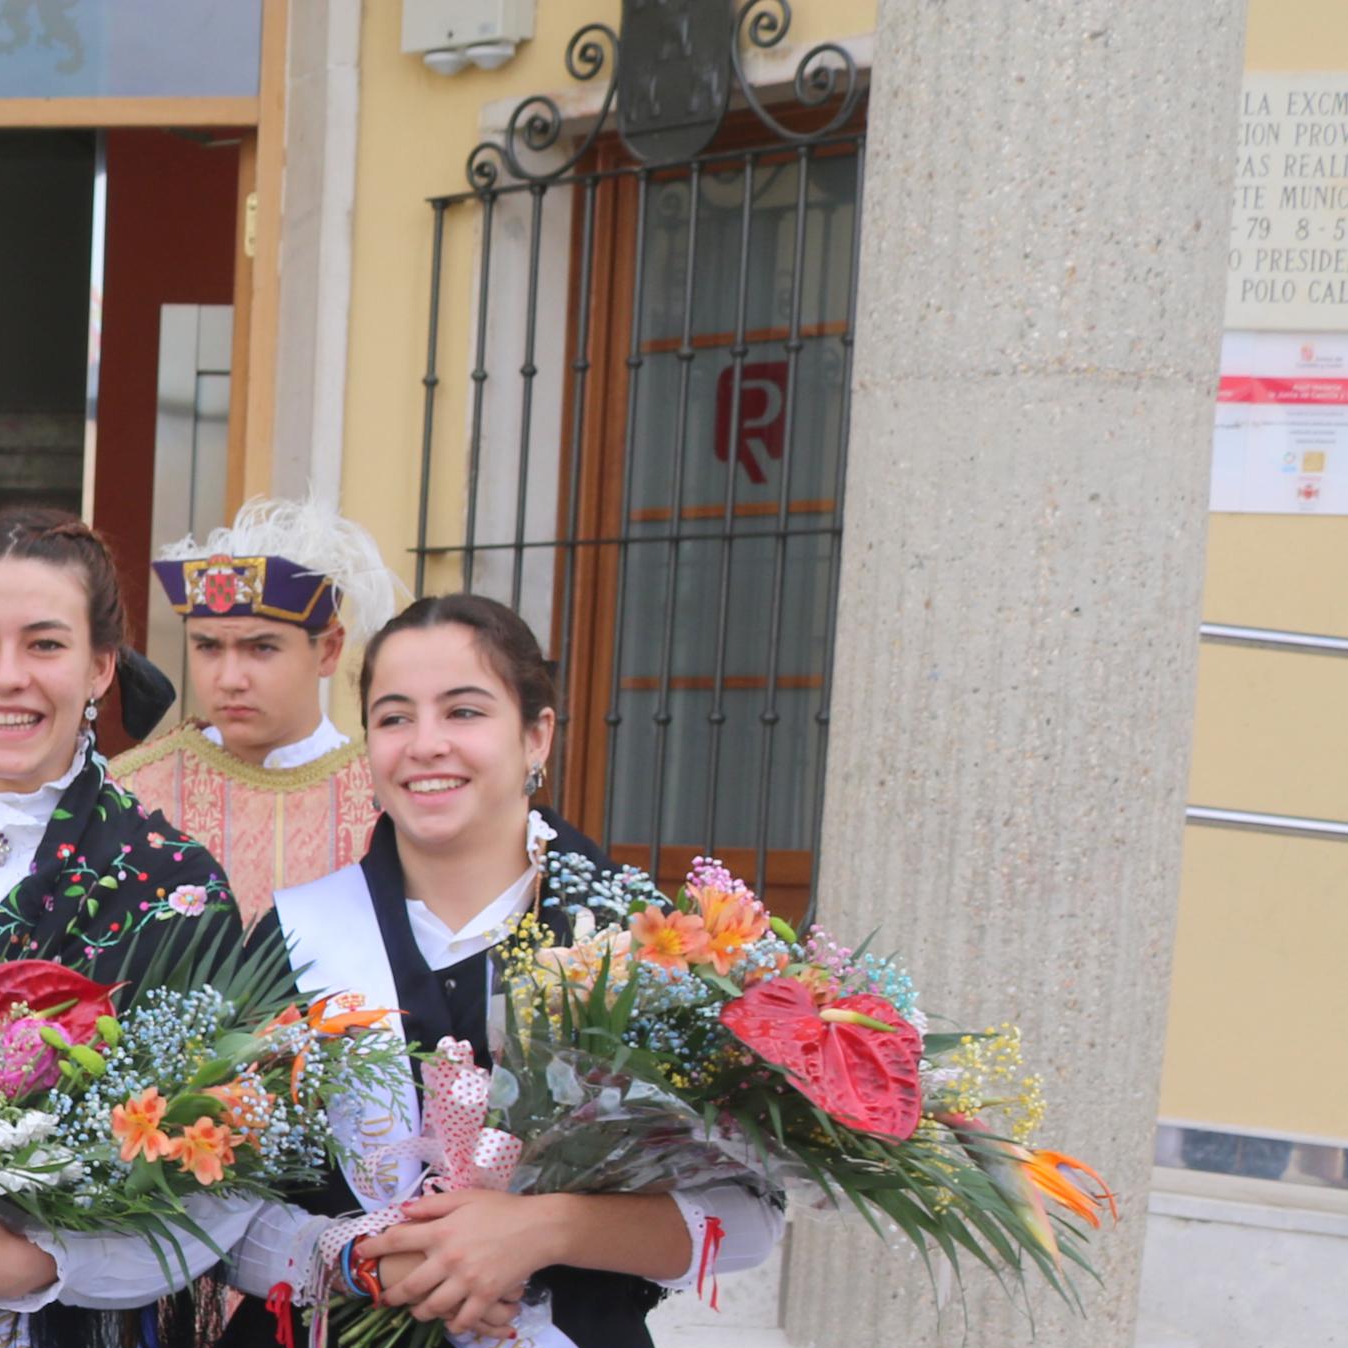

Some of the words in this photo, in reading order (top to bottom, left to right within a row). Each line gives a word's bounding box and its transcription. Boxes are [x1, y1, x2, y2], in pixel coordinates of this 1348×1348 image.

[1244, 91, 1271, 116] LA
[1238, 122, 1281, 146] ION
[1235, 154, 1271, 177] AS
[1240, 280, 1297, 303] POLO
